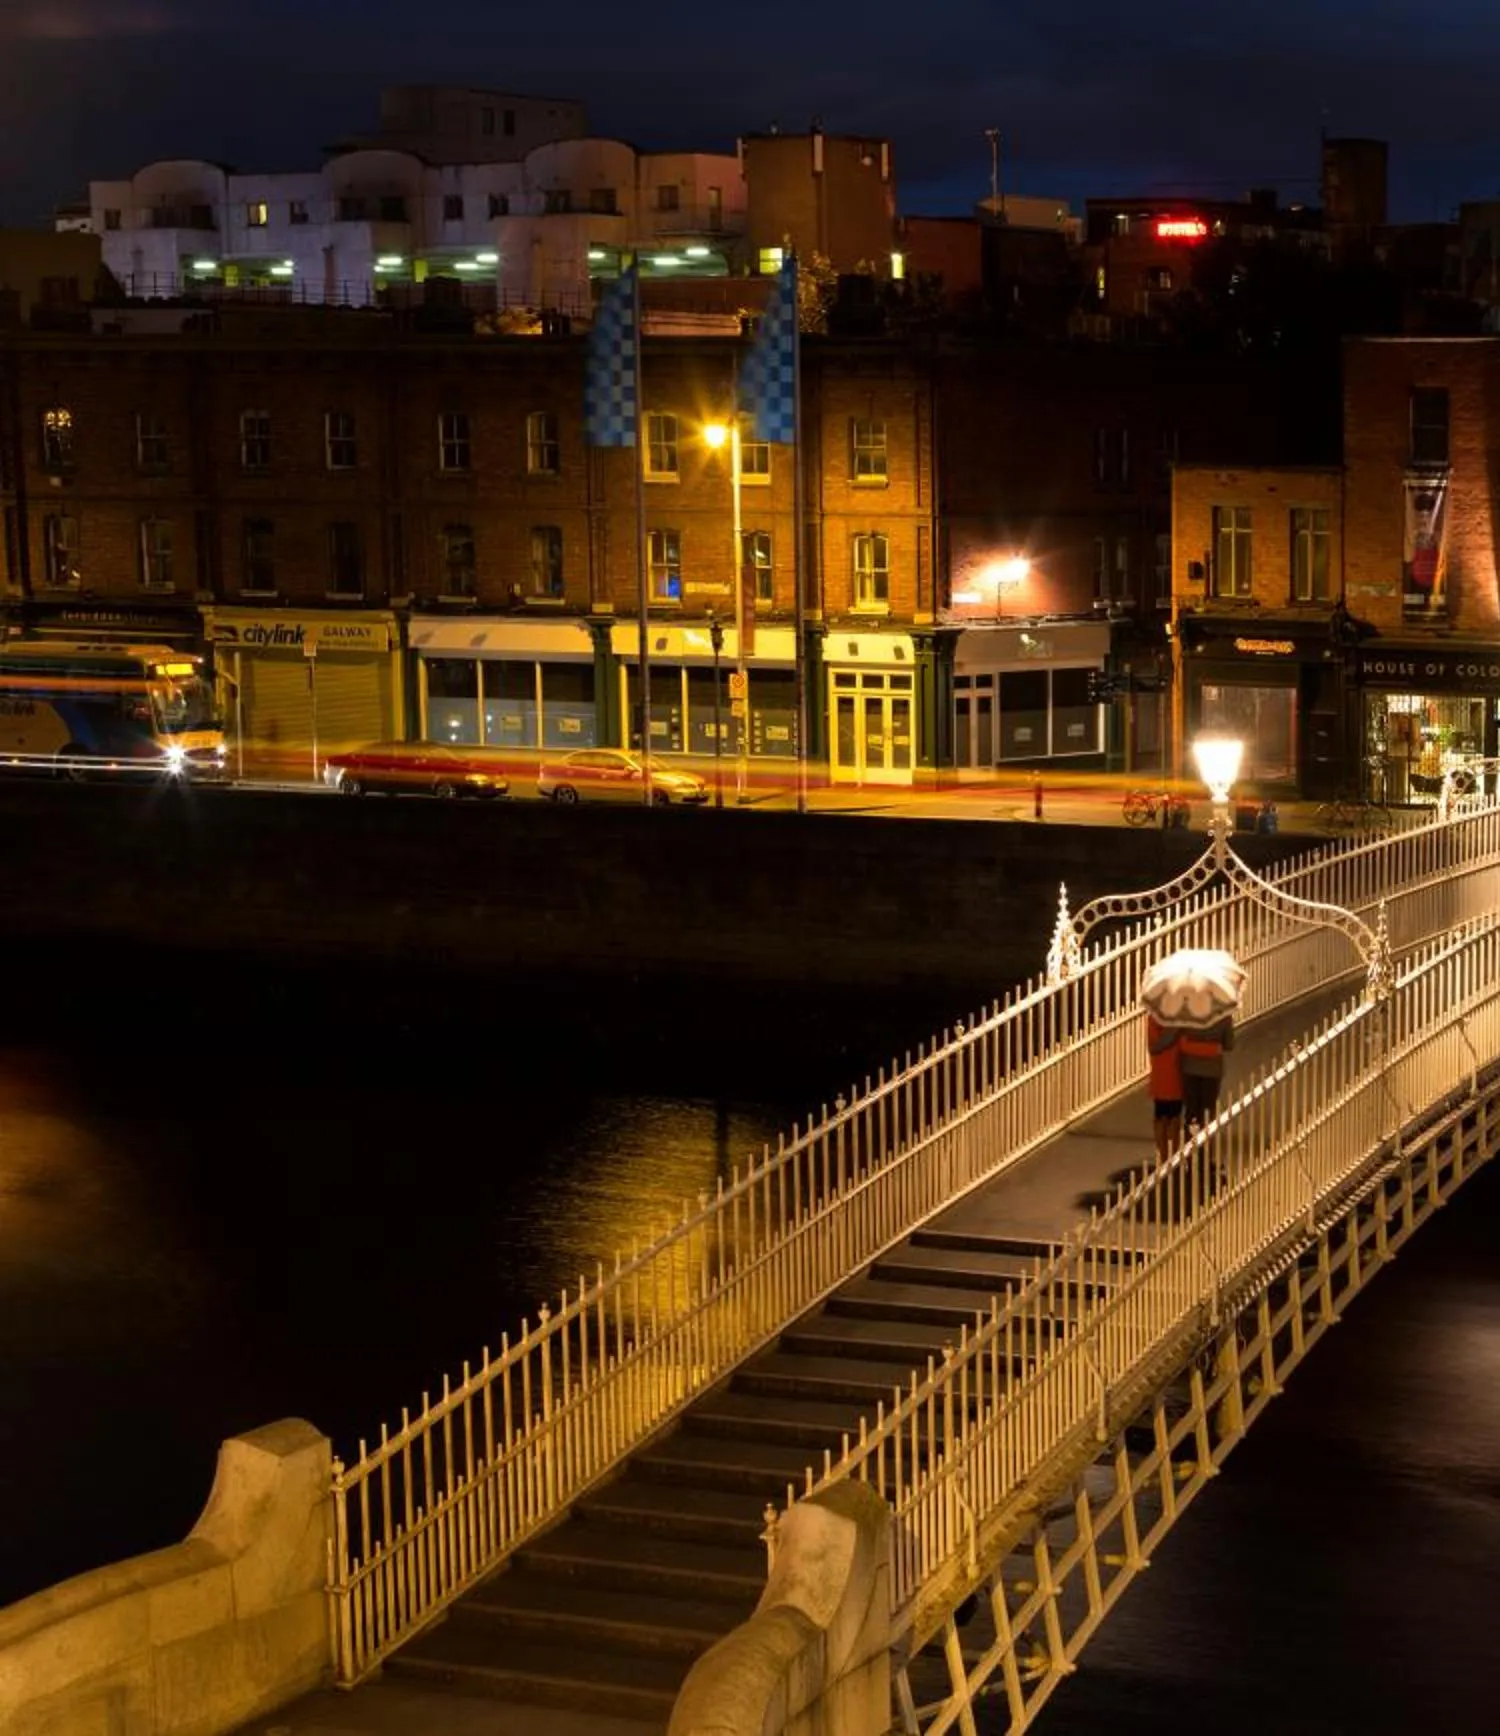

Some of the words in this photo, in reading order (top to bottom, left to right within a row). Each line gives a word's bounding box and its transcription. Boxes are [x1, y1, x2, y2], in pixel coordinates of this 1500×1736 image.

[242, 622, 306, 647] citylink
[323, 625, 371, 637] GALWAY
[1362, 661, 1416, 676] HOUSE
[1424, 663, 1445, 676] OF
